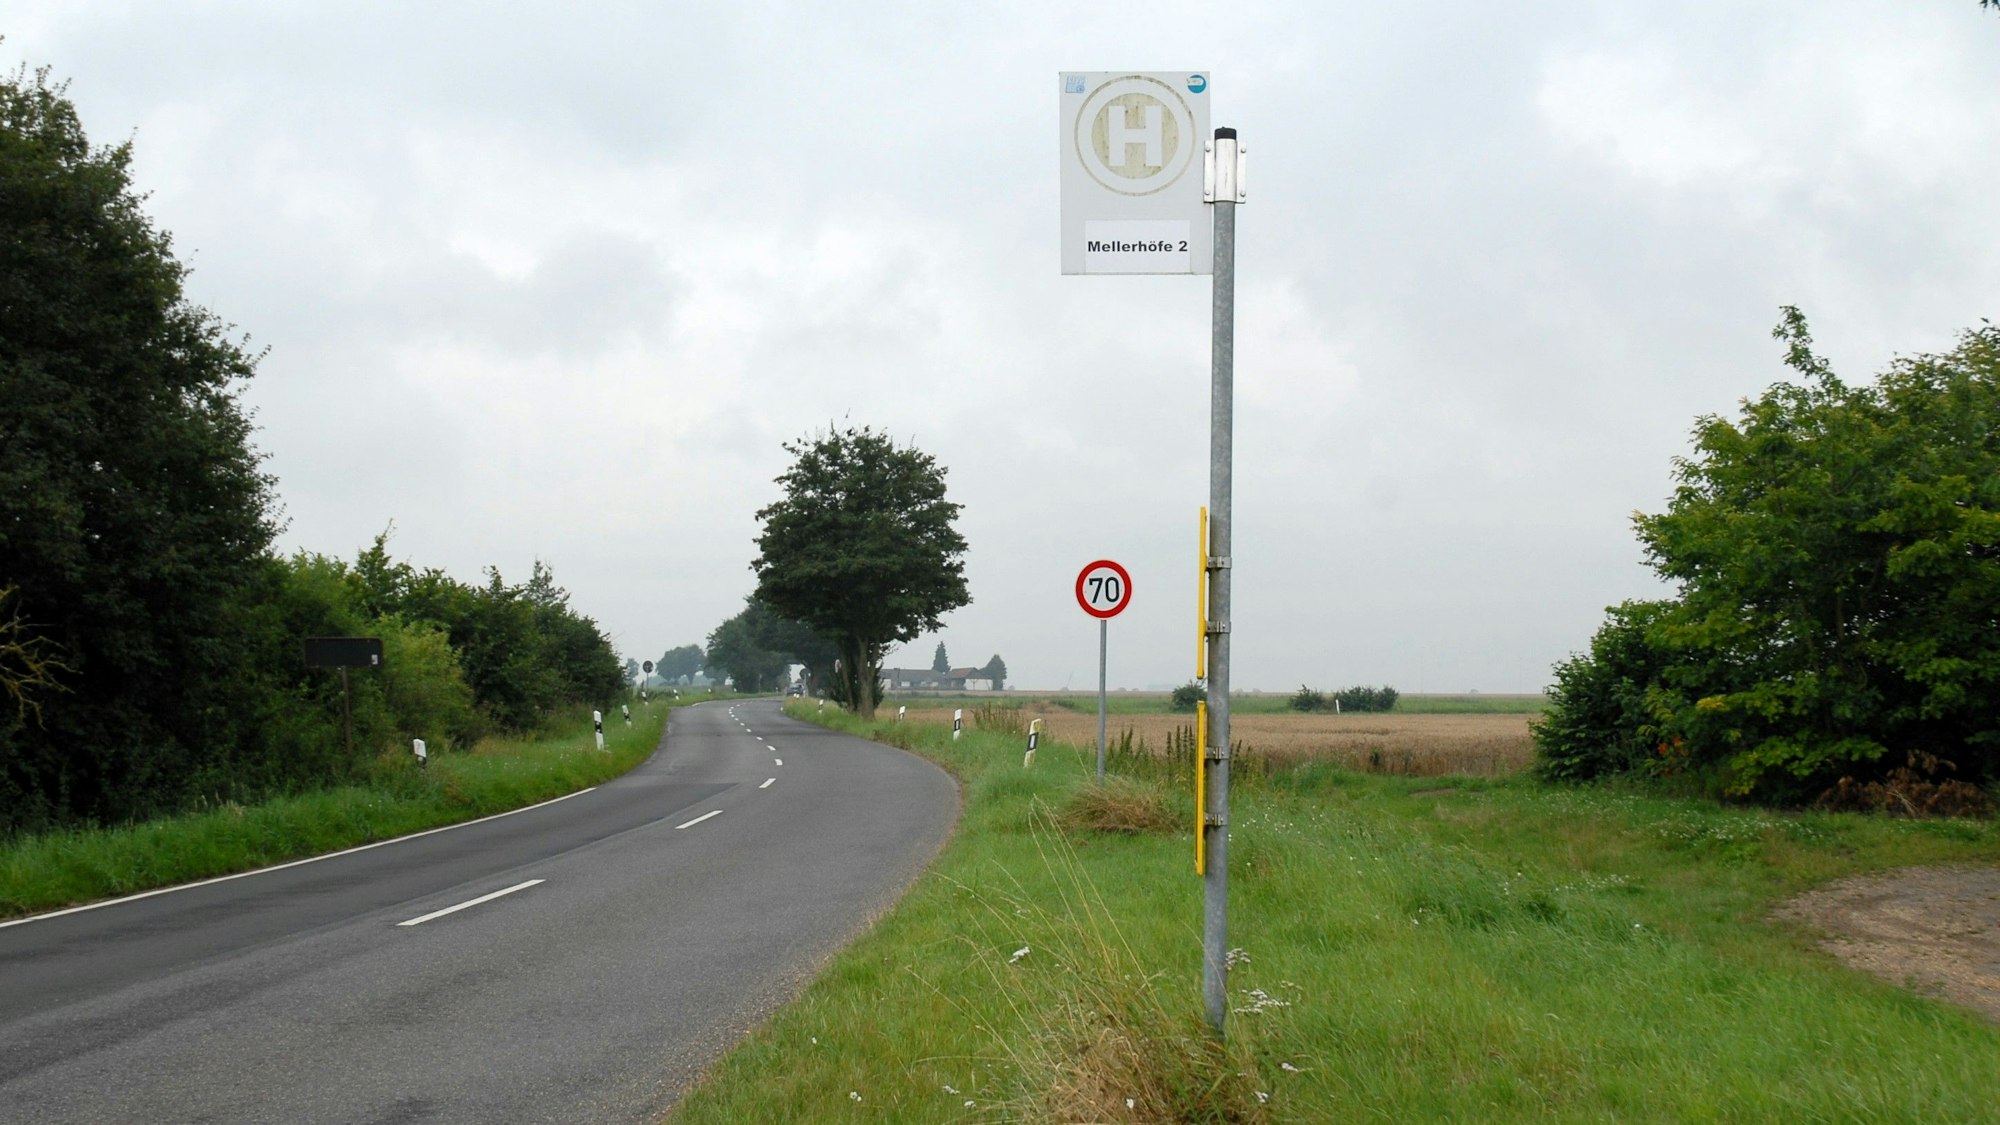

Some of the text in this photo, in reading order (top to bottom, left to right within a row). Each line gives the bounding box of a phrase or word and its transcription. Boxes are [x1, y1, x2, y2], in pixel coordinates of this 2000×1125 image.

[1108, 105, 1163, 167] H
[1087, 240, 1188, 252] Mellerhöfe 2
[1088, 577, 1120, 604] 70
